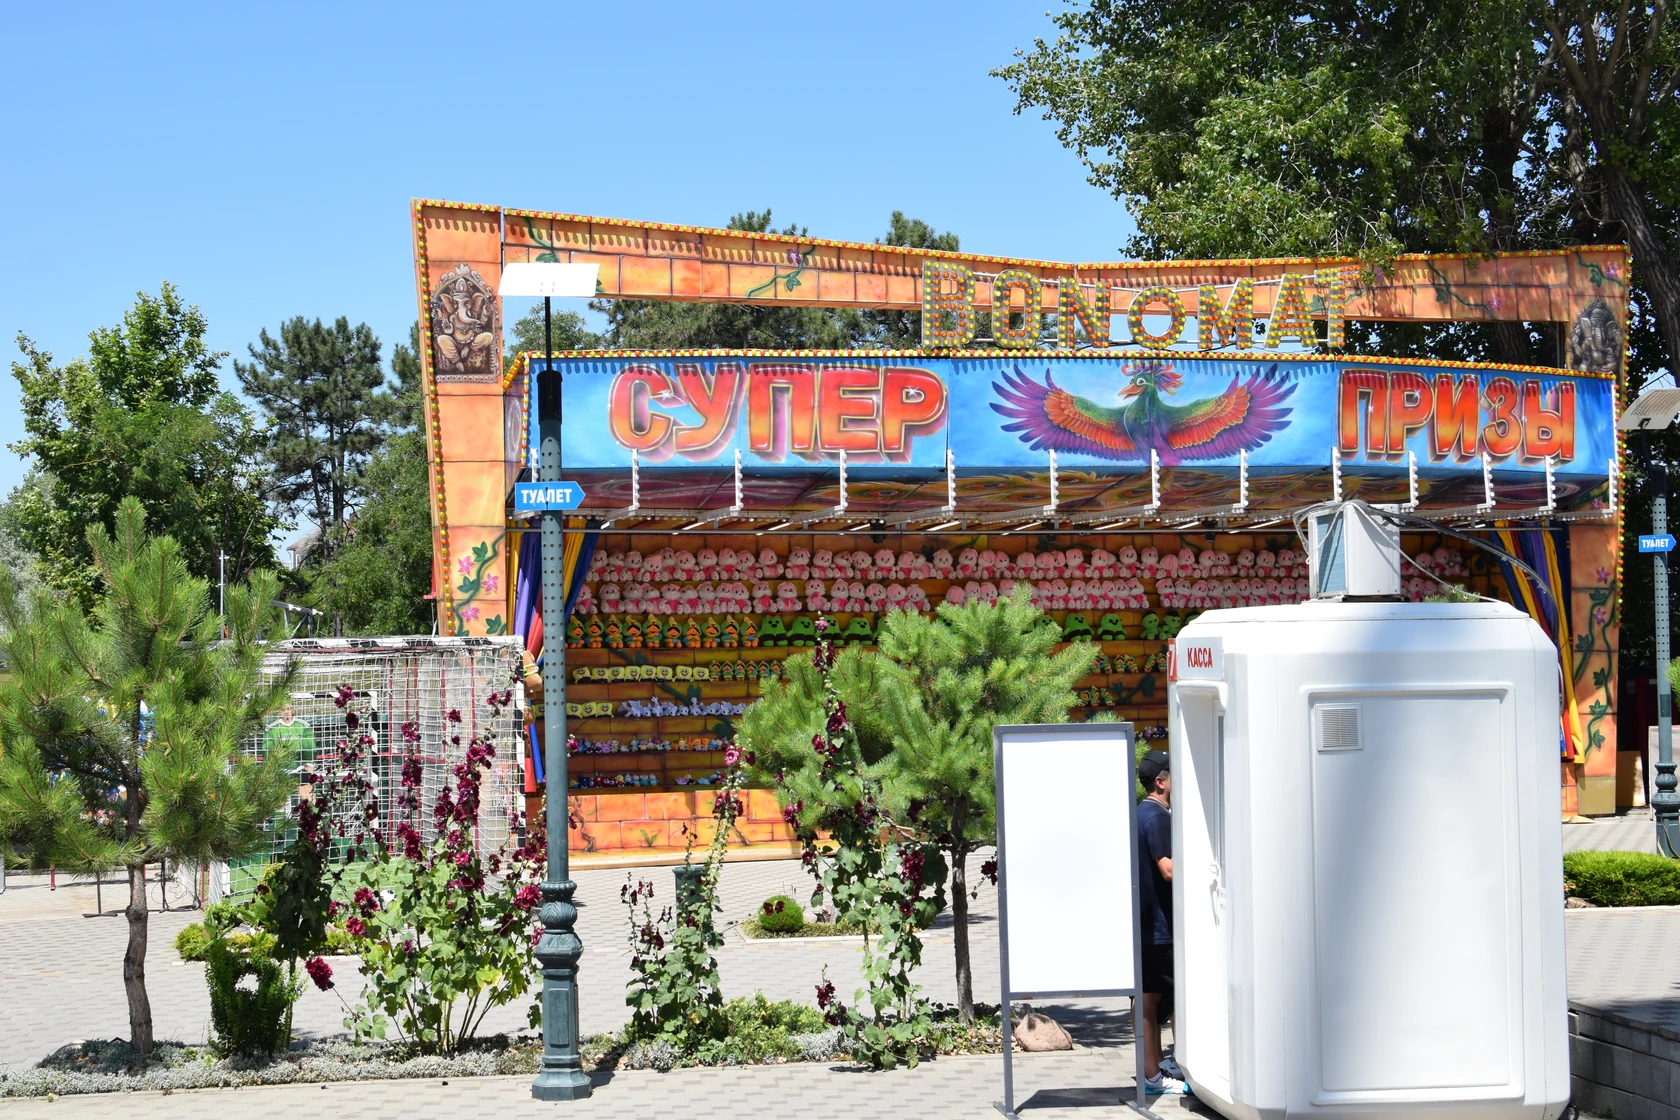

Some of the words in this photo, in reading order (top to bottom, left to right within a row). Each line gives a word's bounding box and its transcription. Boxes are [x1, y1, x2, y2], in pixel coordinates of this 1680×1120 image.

[922, 259, 1361, 350] BONOMAT
[608, 363, 948, 461] СУПЕР
[1338, 368, 1576, 464] ПРИЗЫ
[520, 488, 573, 504] ТУАЛЕТ
[1641, 538, 1670, 549] ТУАЛЕТ
[1187, 647, 1213, 668] КАССА
